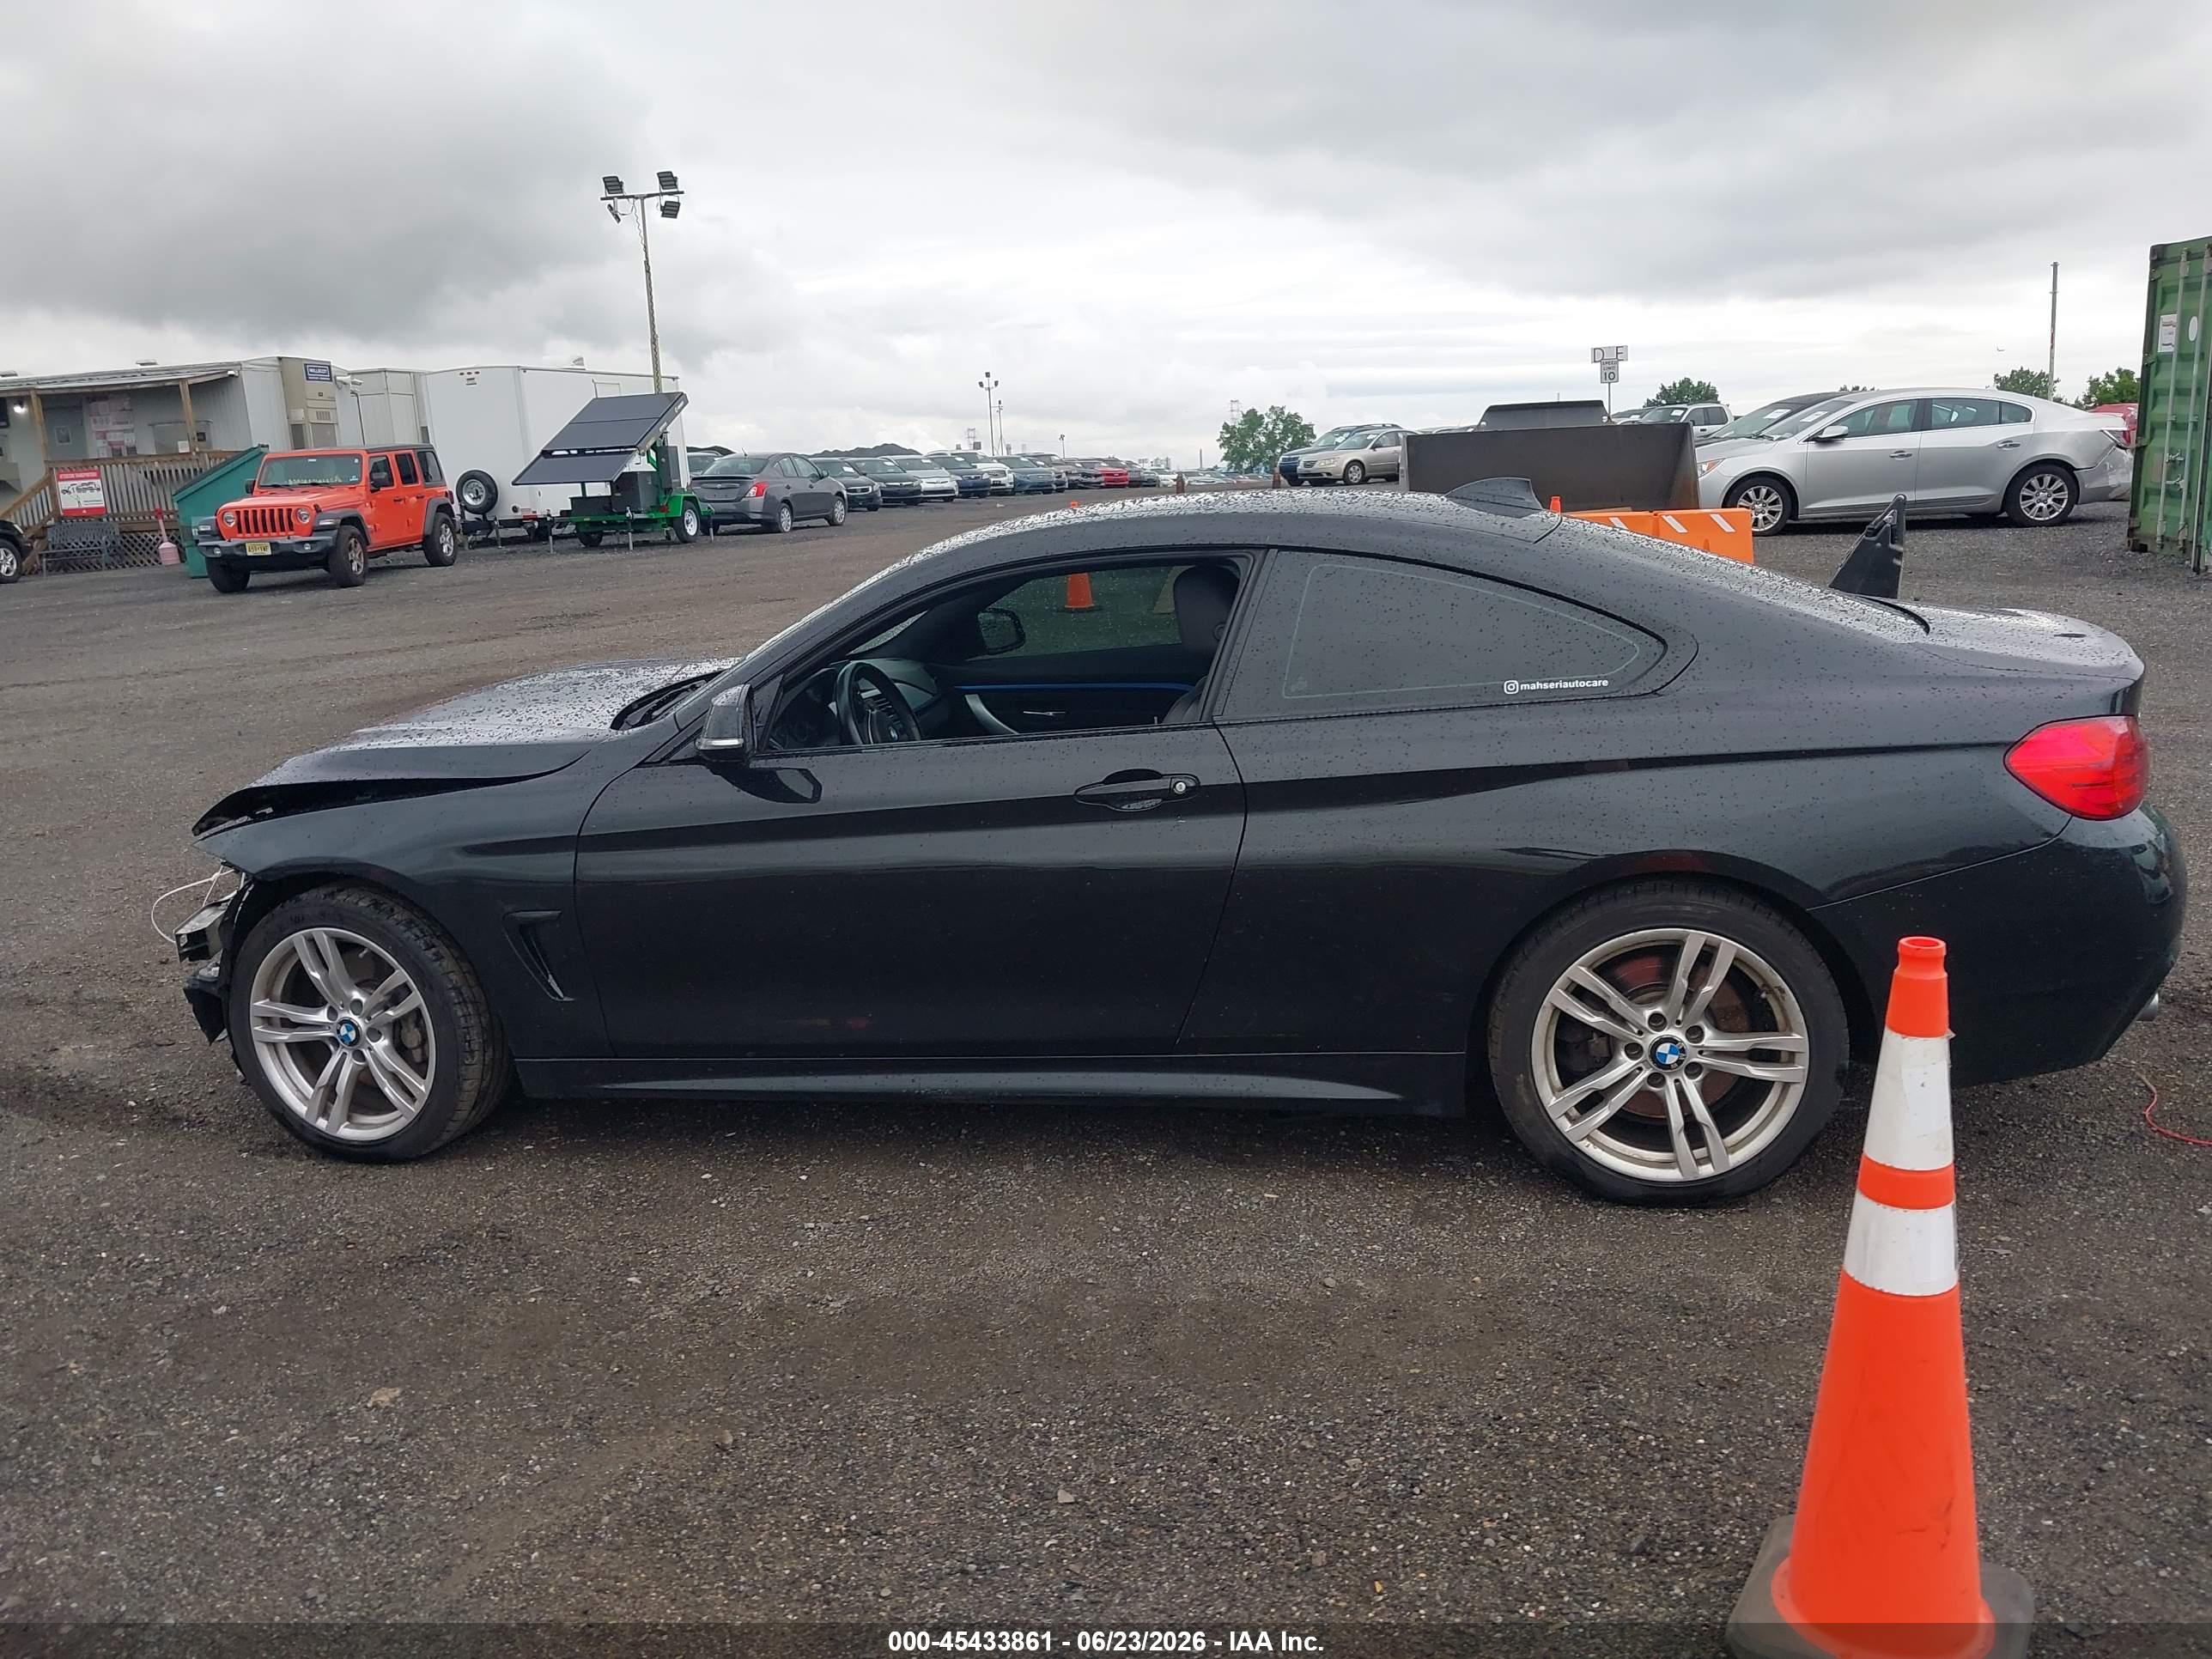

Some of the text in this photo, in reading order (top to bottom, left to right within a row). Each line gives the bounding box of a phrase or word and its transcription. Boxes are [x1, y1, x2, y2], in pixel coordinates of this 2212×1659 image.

[1594, 346, 1624, 362] D E
[1604, 372, 1615, 380] 10
[1520, 679, 1608, 690] mahseriautocare
